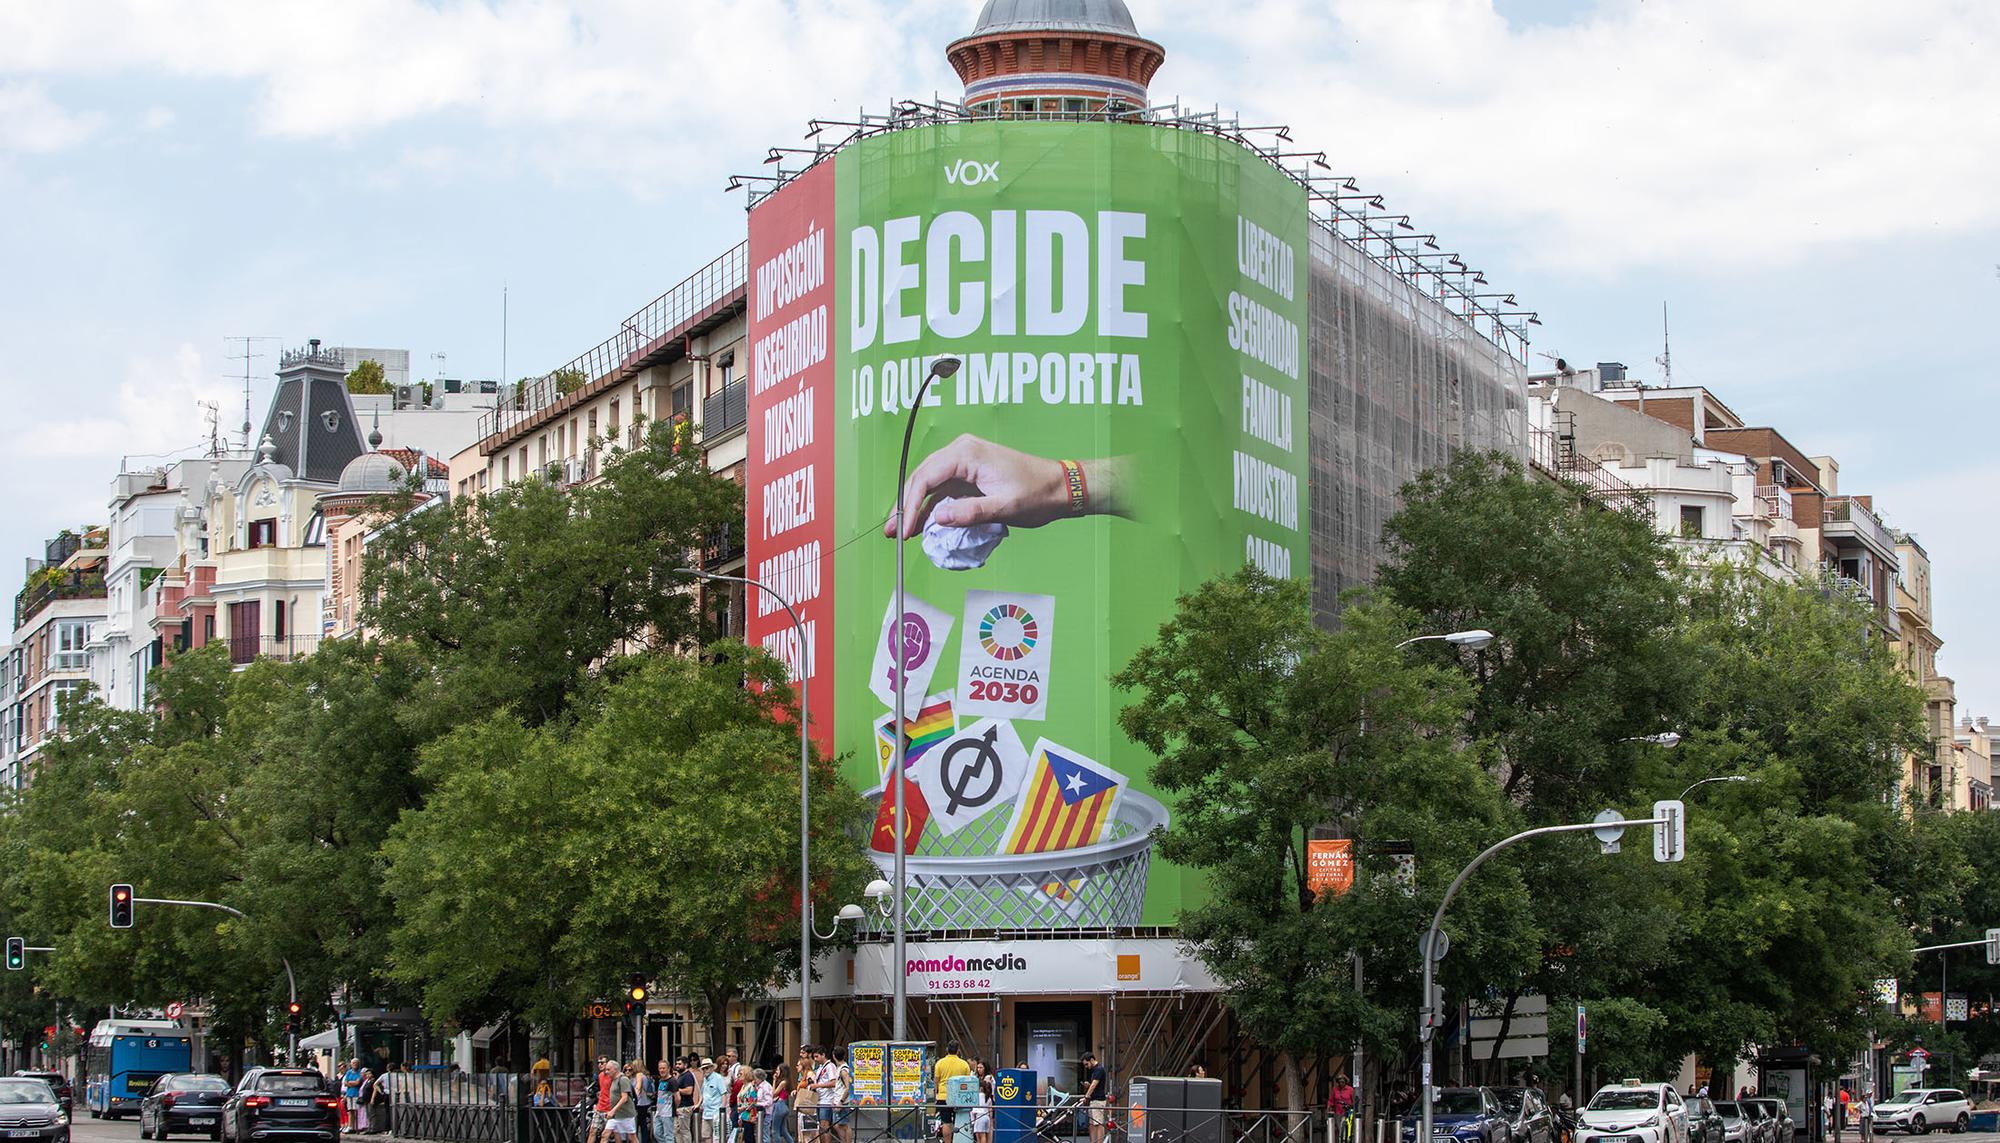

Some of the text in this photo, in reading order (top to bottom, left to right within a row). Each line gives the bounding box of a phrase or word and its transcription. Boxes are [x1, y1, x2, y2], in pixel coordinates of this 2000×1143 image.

[944, 159, 999, 185] VOX
[756, 218, 825, 324] IMPOSICIÓN
[851, 210, 1148, 353] DECIDE
[1237, 214, 1294, 302] LIBERTAD
[754, 304, 827, 397] INSEGURIDAD
[1227, 290, 1299, 381] SEGURIDAD
[764, 376, 814, 465] DIVISIÓN
[851, 352, 1144, 420] LO QUE IMPORTA
[1242, 373, 1293, 453] FAMILIA
[763, 464, 815, 541] POBREZA
[1233, 449, 1299, 532] INDUSTRIA
[758, 539, 821, 618] ABANDONO
[969, 665, 1040, 682] AGENDA
[969, 680, 1039, 705] 2030
[1312, 851, 1348, 859] FERNÁN
[1312, 859, 1348, 867] GÓMEZ
[928, 979, 990, 989] 91 633 68 42
